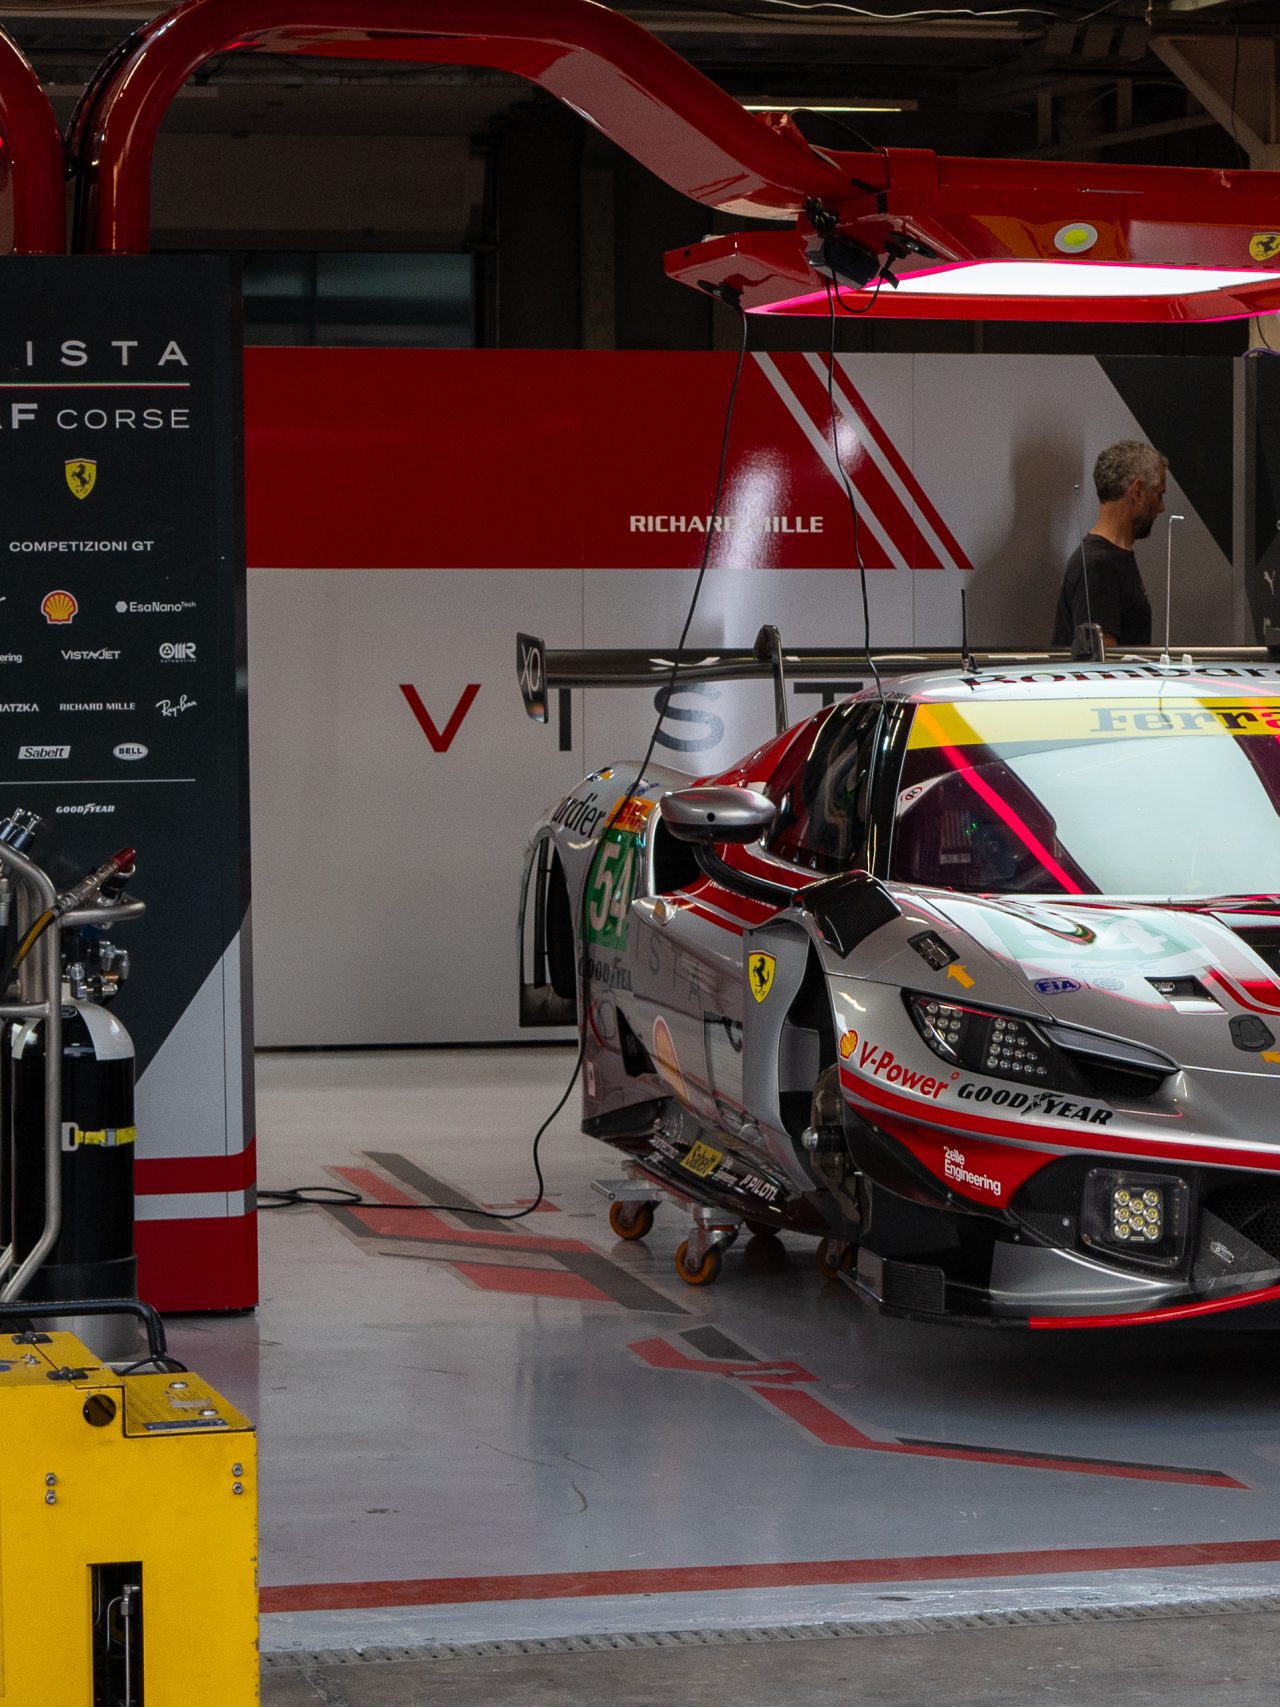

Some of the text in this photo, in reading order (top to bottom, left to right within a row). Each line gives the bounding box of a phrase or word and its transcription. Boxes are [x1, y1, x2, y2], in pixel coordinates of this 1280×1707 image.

[0, 403, 190, 429] F CORSE
[749, 516, 823, 533] ILLE
[9, 541, 154, 552] COMPETIZIONI GT
[60, 703, 136, 711] RICHARD MILLE
[24, 747, 65, 758] Sabelt
[119, 747, 143, 755] BELL
[56, 803, 115, 815] GOODYEAR
[589, 842, 635, 937] 54
[1038, 980, 1077, 993] FIA
[858, 1040, 949, 1100] V-Power
[957, 1083, 1114, 1126] GOODYEAR
[943, 1145, 965, 1165] 2elle
[944, 1158, 1001, 1196] Engineering
